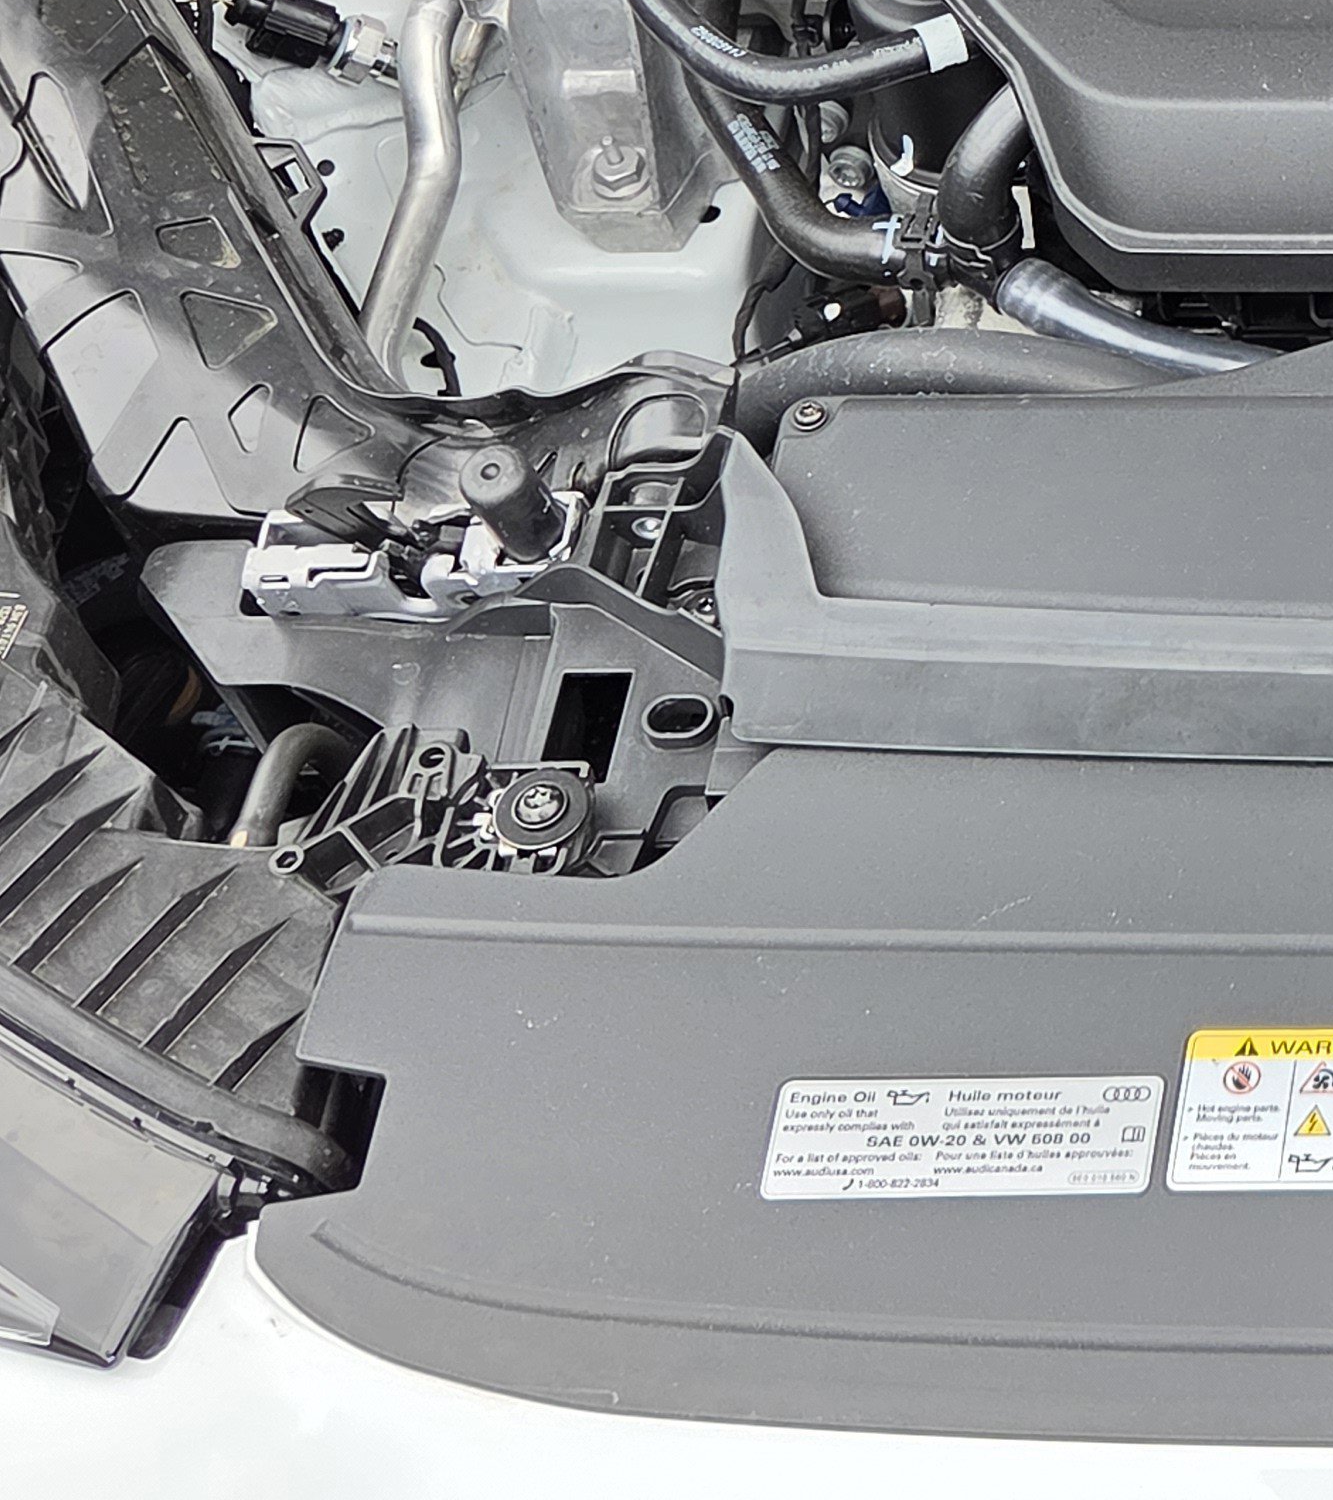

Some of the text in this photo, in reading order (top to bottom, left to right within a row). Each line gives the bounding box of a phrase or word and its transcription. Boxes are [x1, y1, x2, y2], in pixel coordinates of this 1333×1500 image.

[790, 1091, 876, 1105] Engine Oil
[948, 1090, 1063, 1102] Huile moteur
[784, 1109, 879, 1120] Use only oil that
[944, 1107, 984, 1117] Utilisez
[988, 1106, 1056, 1118] uniquement
[1058, 1105, 1073, 1115] de
[782, 1121, 916, 1133] expressly complies with
[942, 1121, 961, 1131] qui
[963, 1120, 1008, 1129] satisfait
[1010, 1119, 1091, 1130] expressément
[866, 1135, 904, 1147] SAE
[909, 1134, 966, 1147] 0W-20
[972, 1134, 986, 1145] &
[994, 1133, 1026, 1145] VW
[1069, 1132, 1091, 1144] 00
[775, 1153, 795, 1163] For
[807, 1153, 824, 1163] list
[827, 1152, 840, 1162] of
[842, 1152, 896, 1164] approved
[898, 1152, 921, 1162] oils:
[935, 1151, 962, 1160] Pour
[965, 1152, 987, 1160] une
[989, 1150, 1013, 1160] liste
[773, 1167, 875, 1177] www.audiusa.com
[933, 1164, 1043, 1174] www.audicanada.ca
